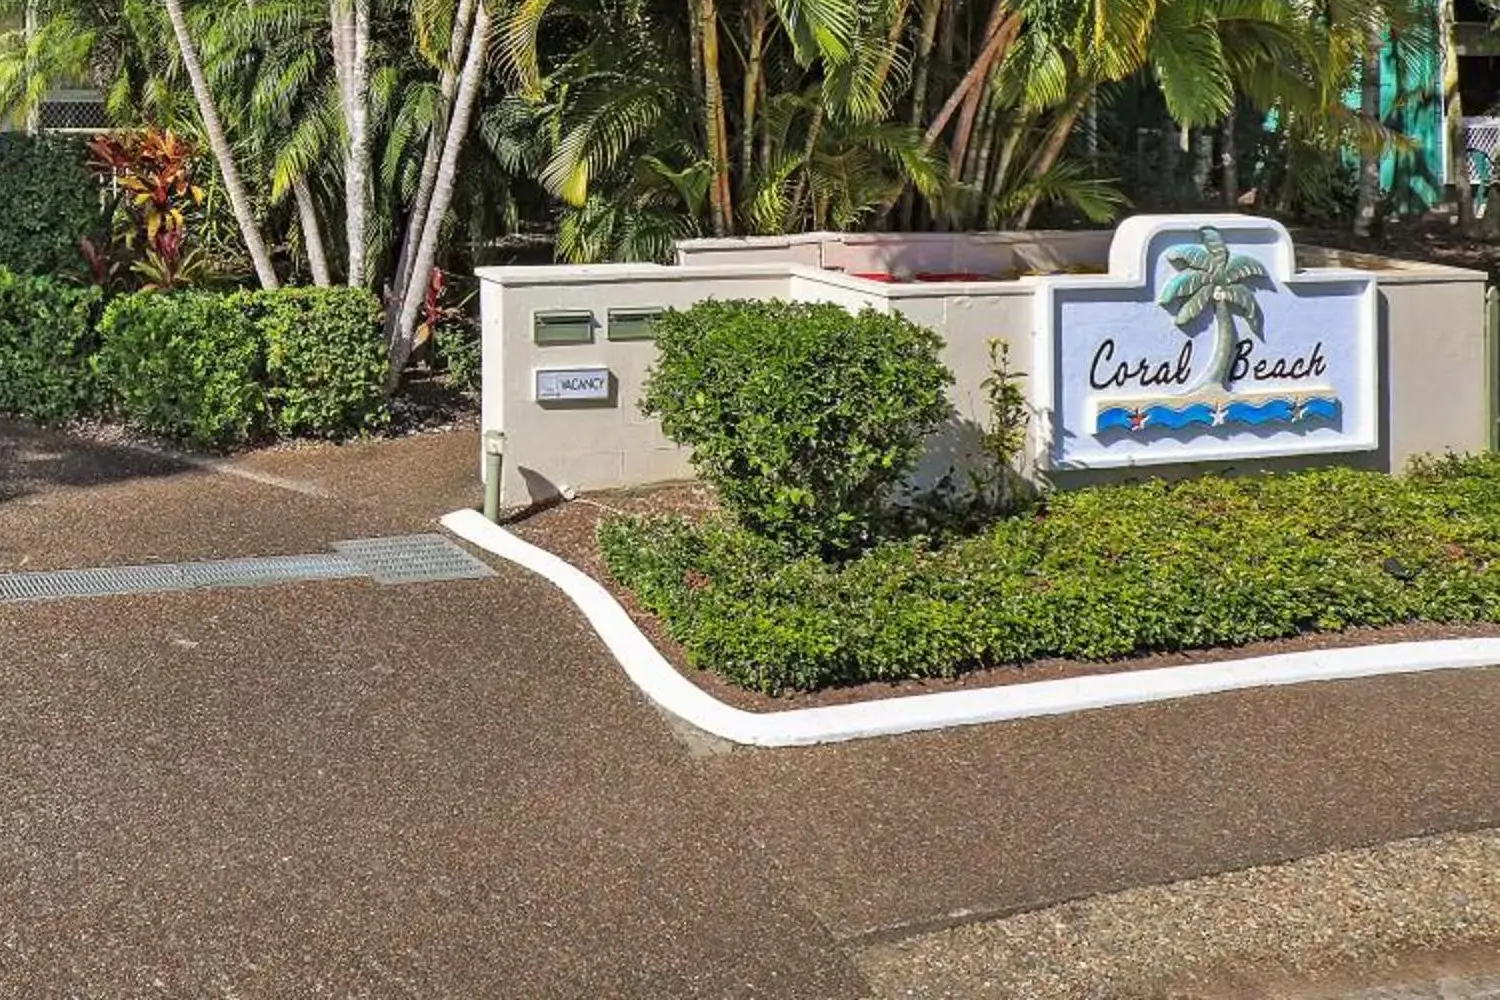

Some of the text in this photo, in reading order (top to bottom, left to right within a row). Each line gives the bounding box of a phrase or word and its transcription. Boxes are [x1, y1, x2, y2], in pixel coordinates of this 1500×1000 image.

[1089, 339, 1326, 390] Coral Beach
[561, 377, 605, 391] VACANCY
